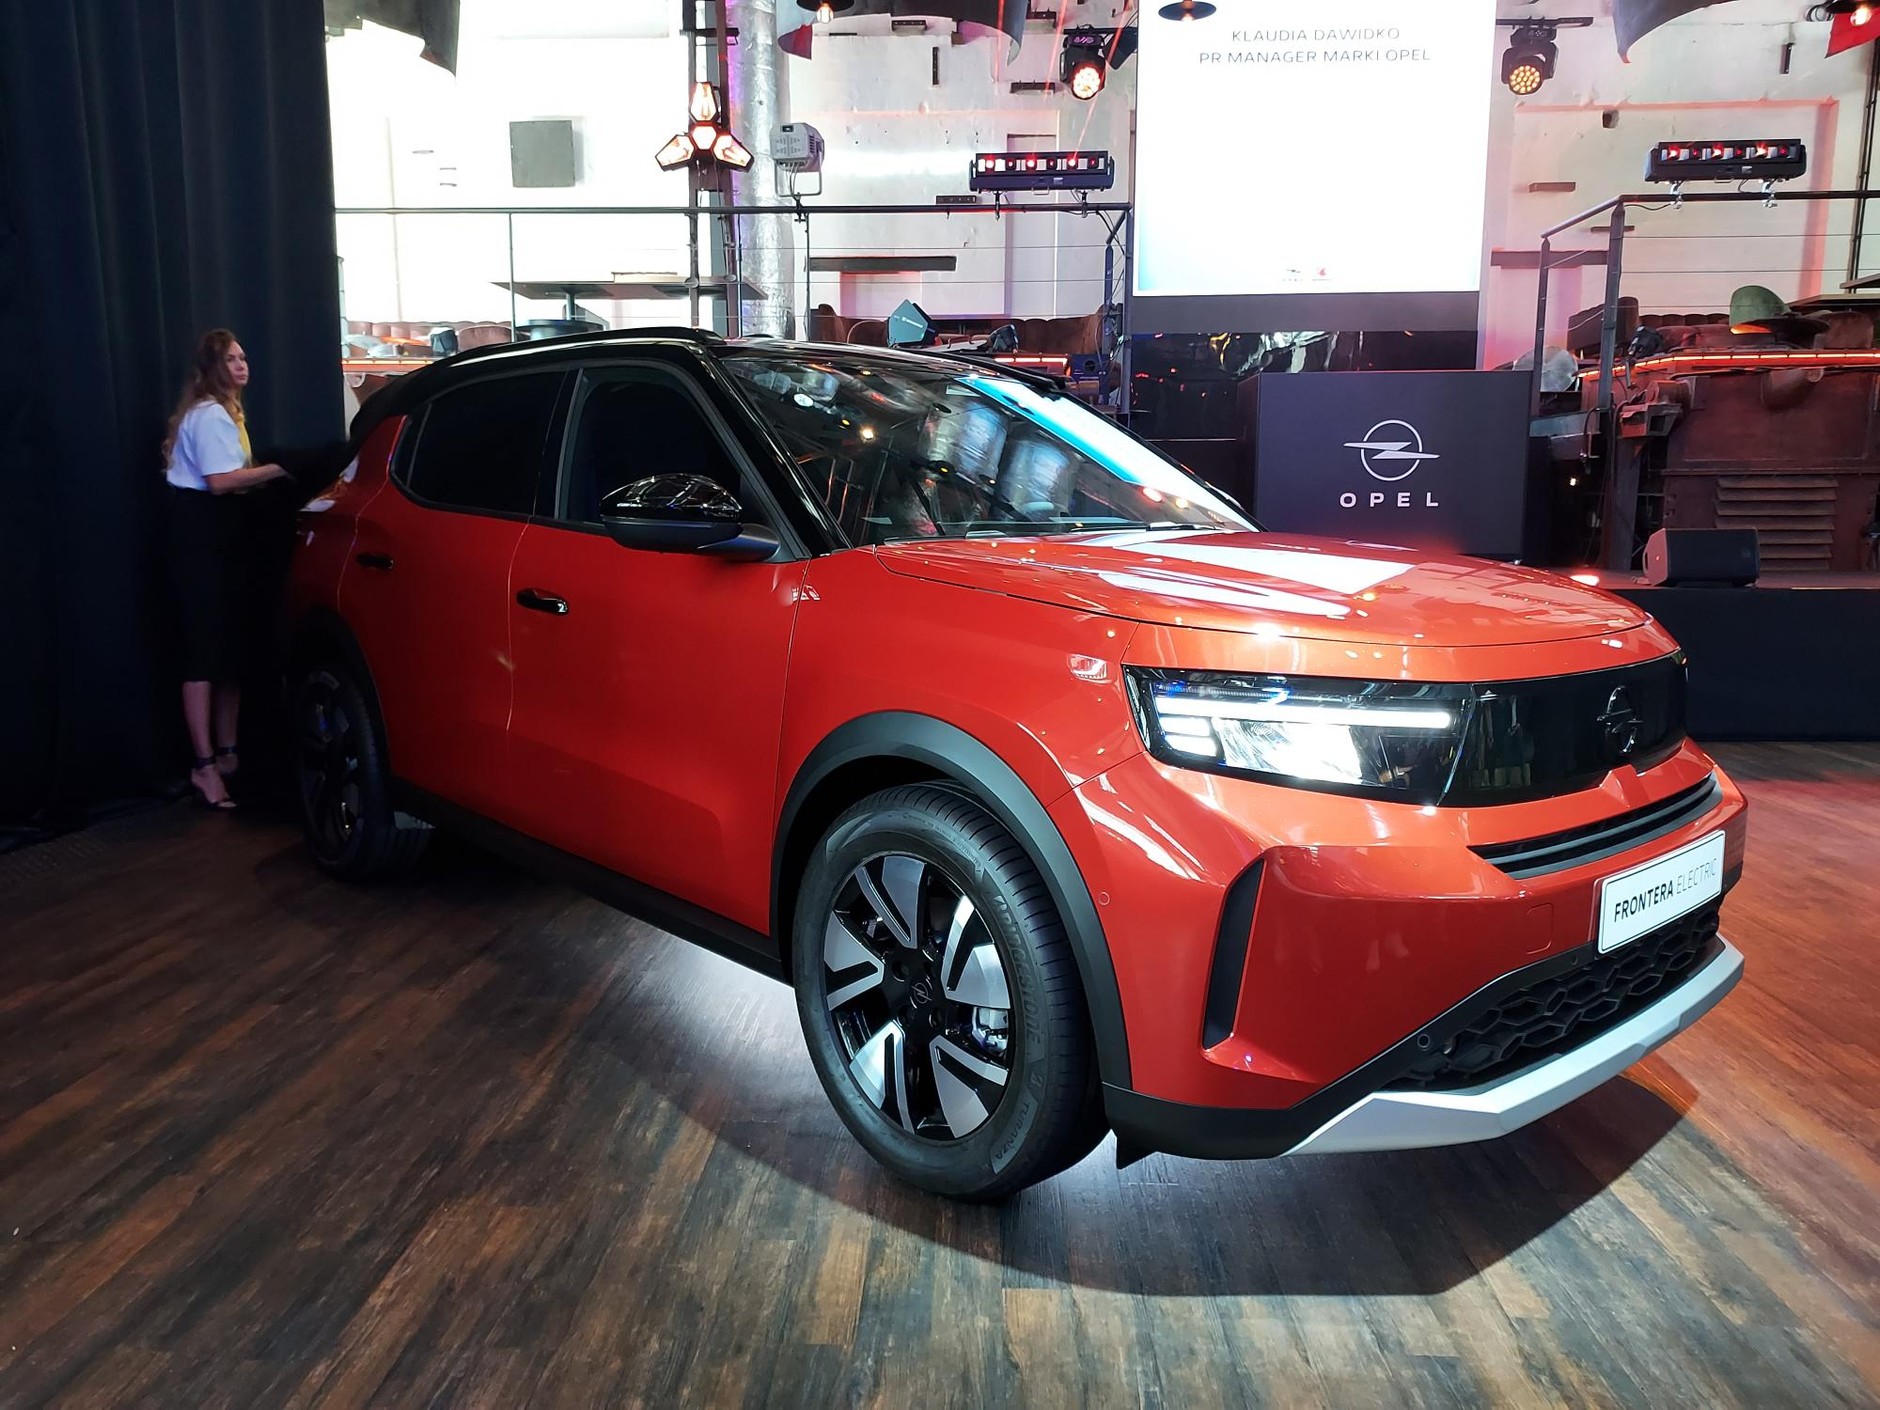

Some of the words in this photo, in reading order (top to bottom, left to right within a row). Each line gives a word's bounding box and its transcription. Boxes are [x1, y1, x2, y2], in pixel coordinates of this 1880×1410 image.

[1232, 30, 1307, 42] KLAUDIA
[1314, 28, 1400, 41] DAWIDKO
[1199, 52, 1222, 64] PR
[1228, 51, 1317, 63] MANAGER
[1323, 50, 1379, 62] MARKI
[1385, 49, 1430, 61] OPEL
[1339, 492, 1439, 508] OPEL
[1614, 880, 1674, 923] FRONTERA
[1676, 858, 1718, 895] ELECTRIC
